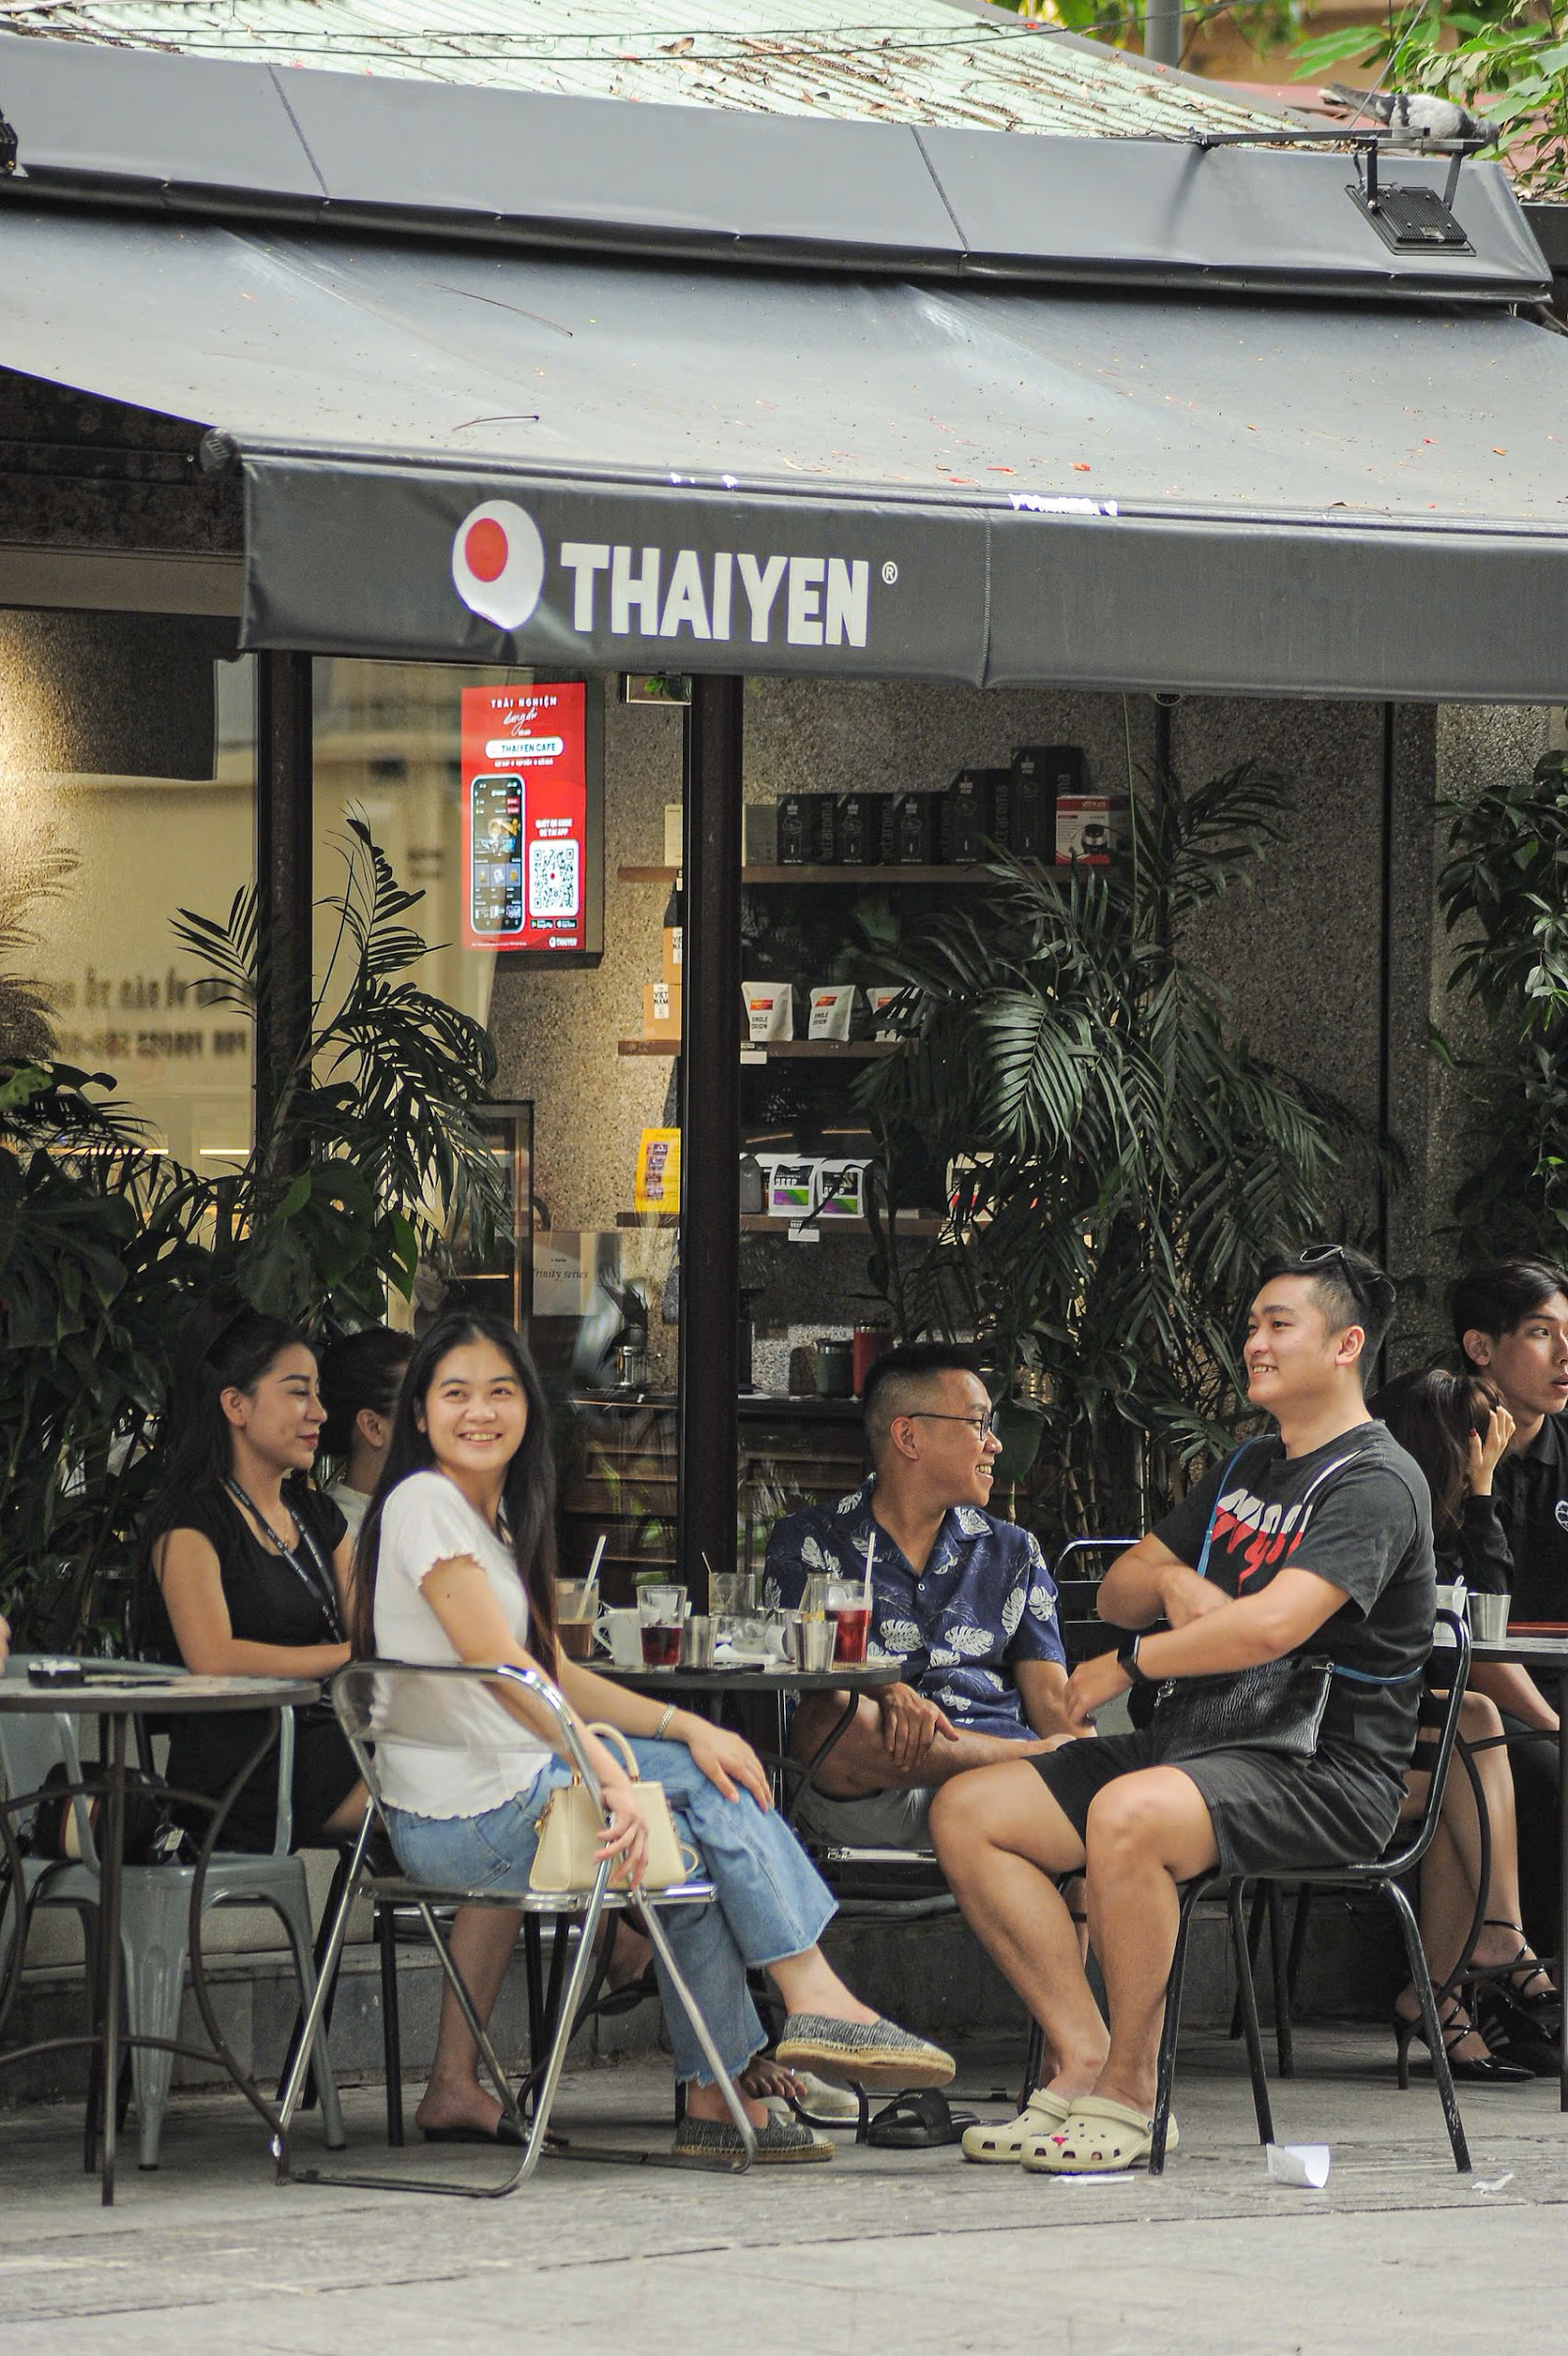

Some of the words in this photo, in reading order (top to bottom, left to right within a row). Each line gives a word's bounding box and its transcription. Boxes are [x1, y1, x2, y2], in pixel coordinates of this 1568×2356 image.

[561, 542, 869, 647] THAIYEN
[502, 744, 534, 754] THAIYEN
[536, 743, 556, 752] CAFE
[563, 1269, 589, 1279] series
